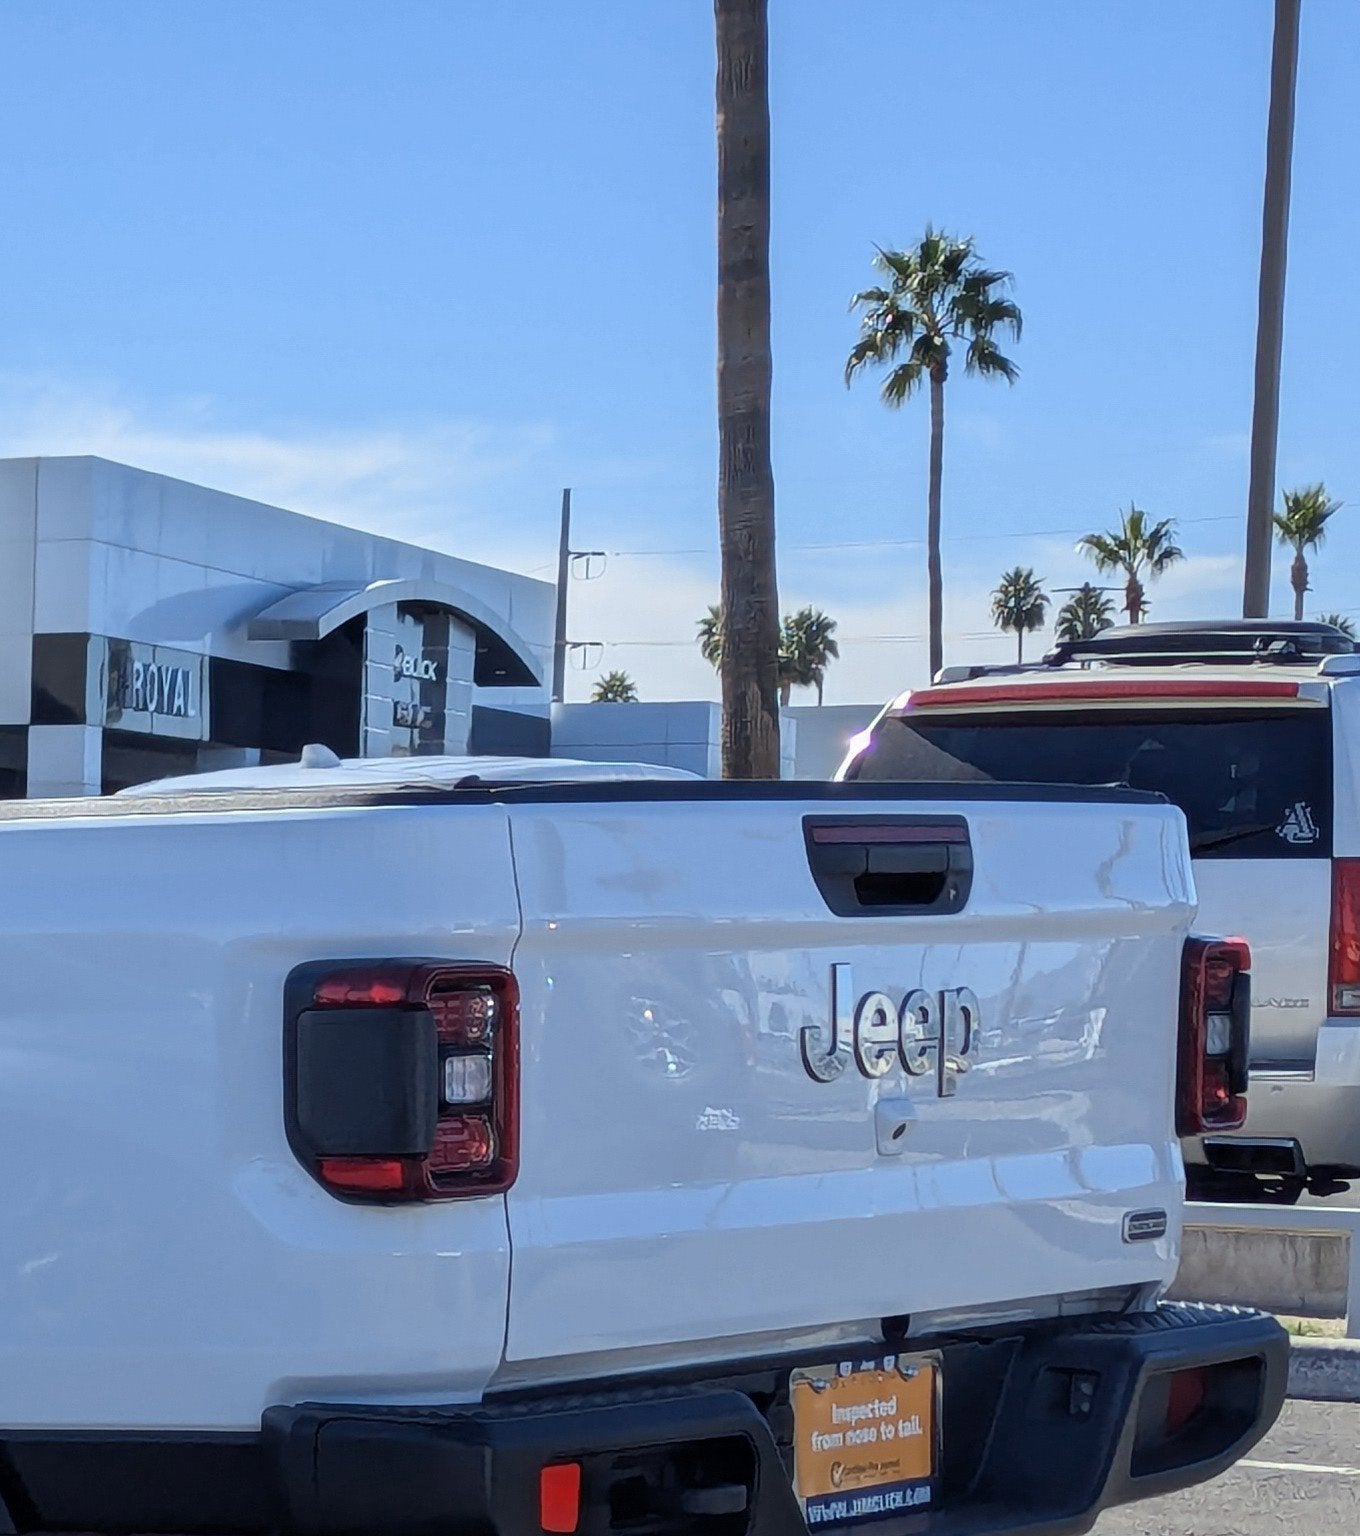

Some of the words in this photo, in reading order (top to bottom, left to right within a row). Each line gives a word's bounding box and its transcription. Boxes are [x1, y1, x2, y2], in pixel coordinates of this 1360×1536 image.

[401, 655, 438, 681] BUICK
[132, 661, 196, 717] ROYAL
[799, 962, 980, 1097] Jeep
[832, 1396, 897, 1426] Inspected
[811, 1431, 843, 1452] from
[845, 1427, 877, 1444] nose
[881, 1421, 895, 1441] to
